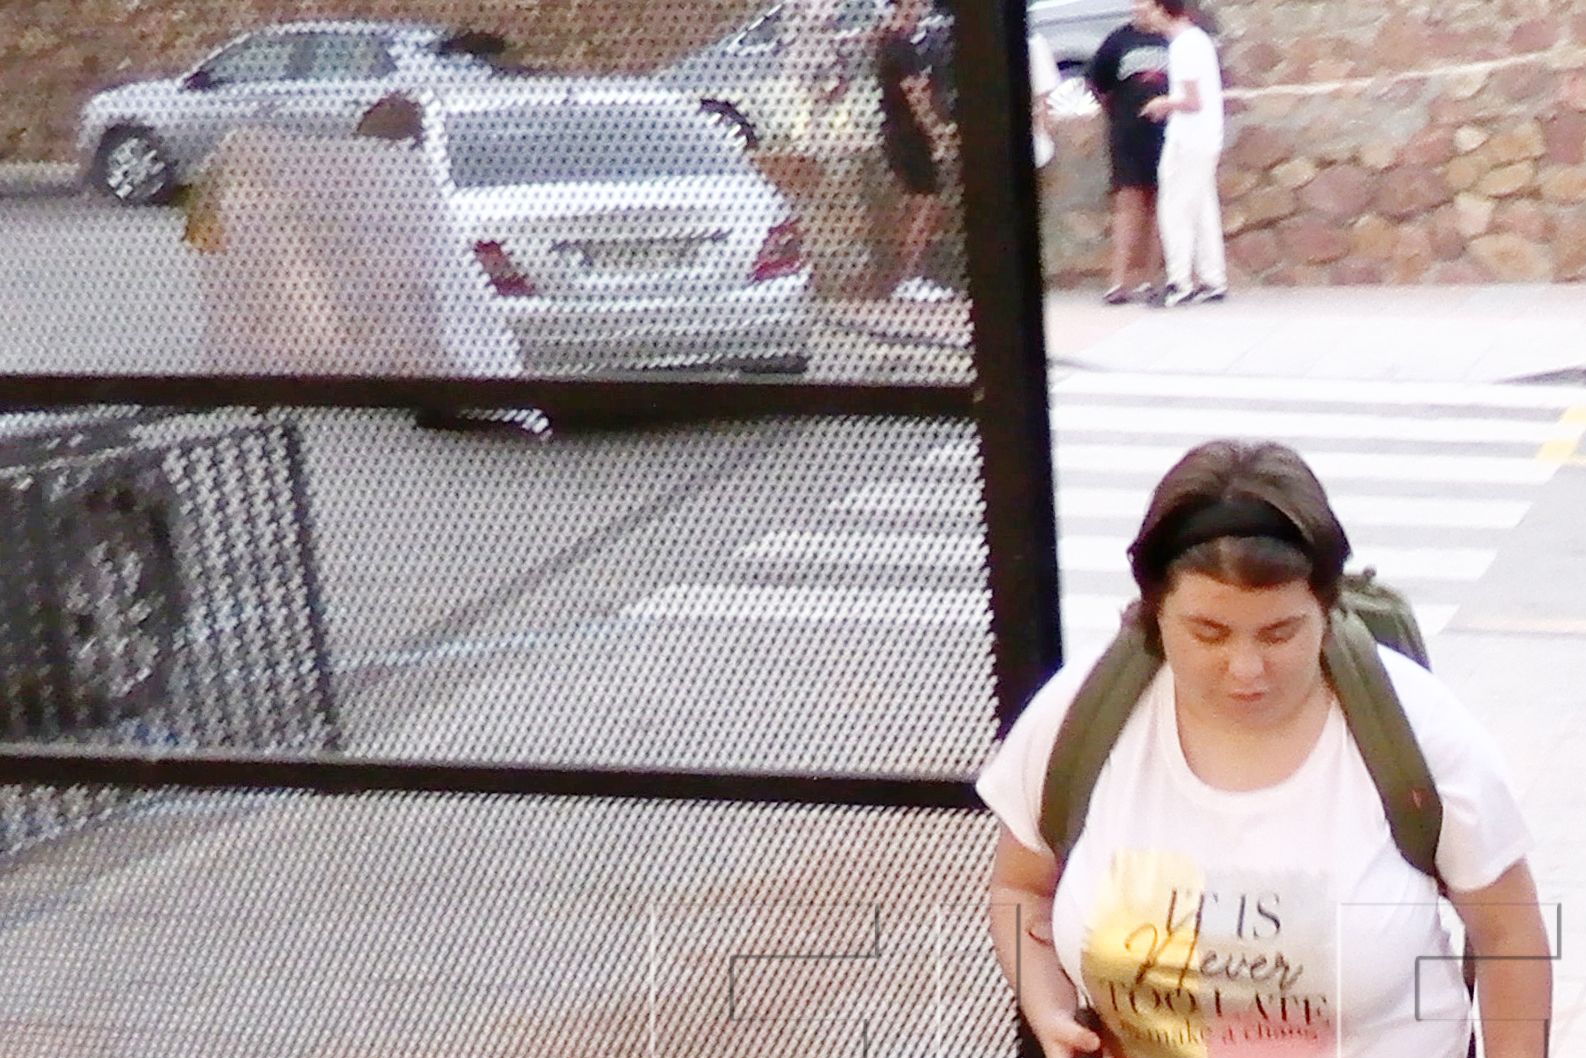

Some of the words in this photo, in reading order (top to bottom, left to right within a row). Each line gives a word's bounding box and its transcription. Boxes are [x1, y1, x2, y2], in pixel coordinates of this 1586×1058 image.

[1164, 888, 1220, 938] IT
[1234, 892, 1282, 939] IS
[1124, 920, 1304, 992] Never
[1107, 979, 1198, 1016] TOO
[1213, 988, 1331, 1027] LATE
